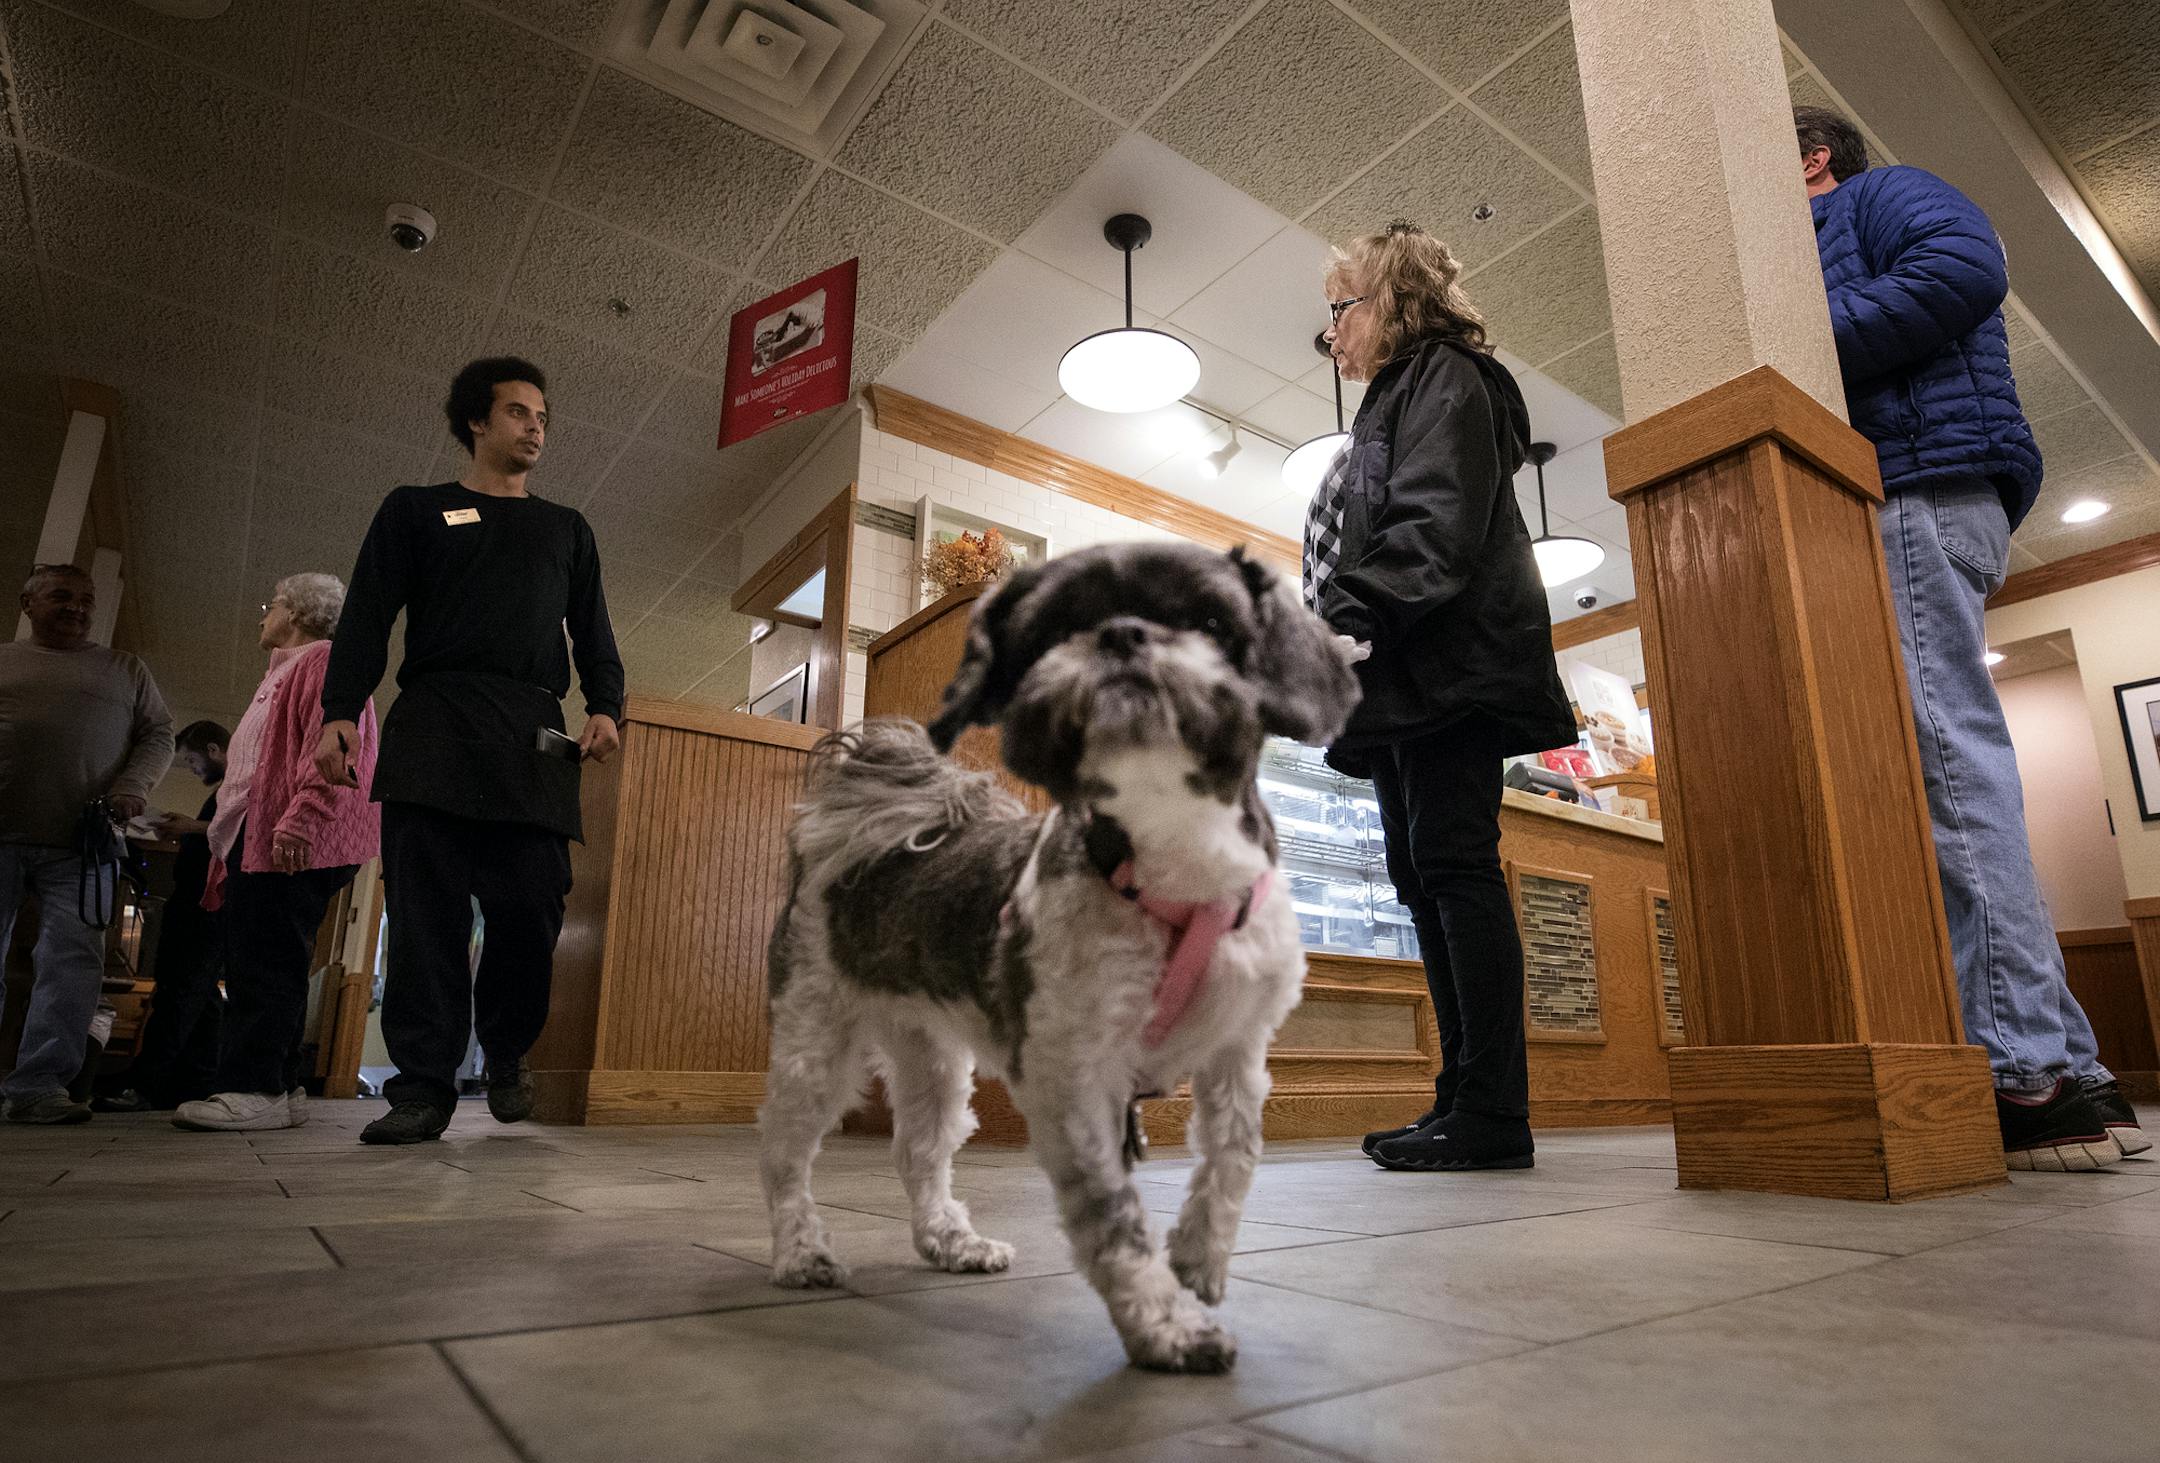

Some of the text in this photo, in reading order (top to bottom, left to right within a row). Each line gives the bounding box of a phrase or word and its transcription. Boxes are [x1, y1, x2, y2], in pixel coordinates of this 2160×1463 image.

[734, 392, 750, 408] MAKE
[781, 369, 805, 388] HOLIDAY
[806, 355, 837, 378] DELICIOUS
